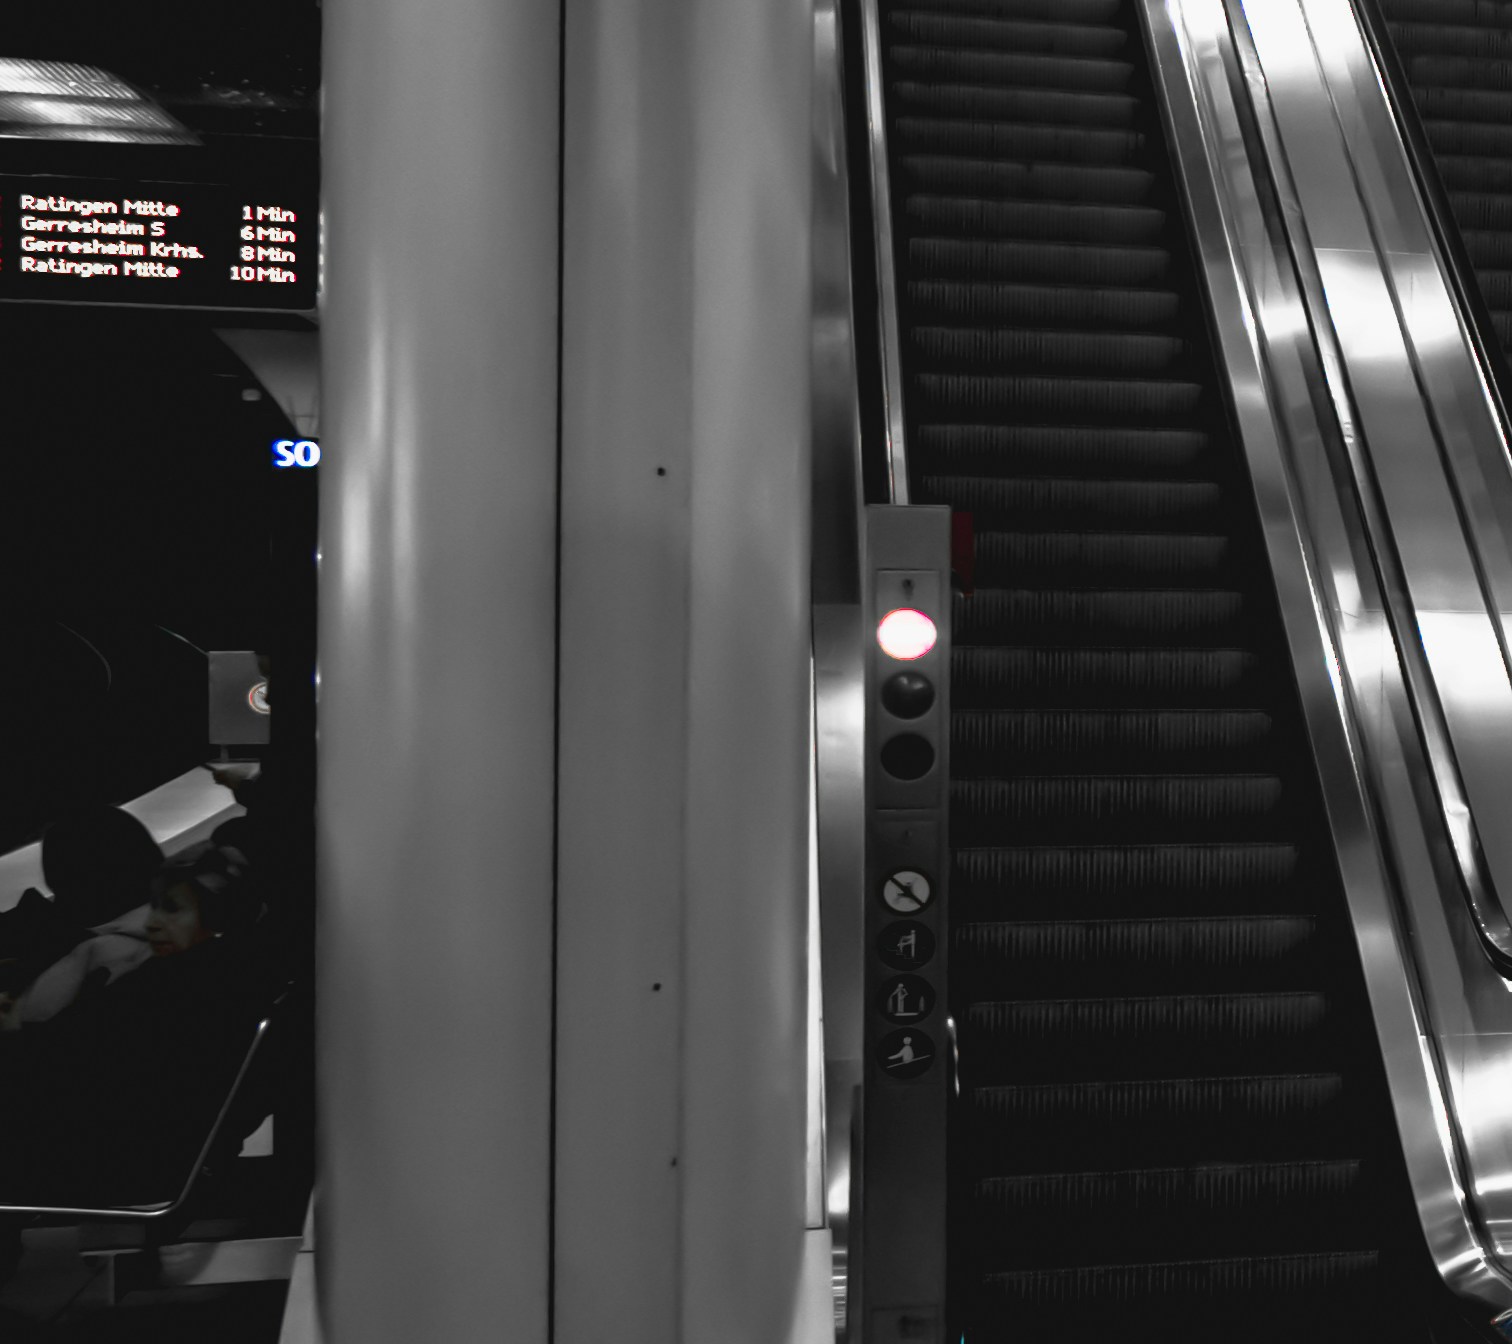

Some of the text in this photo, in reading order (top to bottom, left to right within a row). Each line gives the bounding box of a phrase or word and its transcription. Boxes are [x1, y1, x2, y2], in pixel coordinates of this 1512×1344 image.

[20, 195, 296, 223] Ratingen Mitte 1 Min
[21, 216, 296, 243] Gerresheim S 6 Min
[21, 236, 144, 256] Gerresheim
[239, 245, 254, 262] 8
[256, 246, 296, 263] Min
[20, 256, 296, 283] Ratingen Mitte 10 Min
